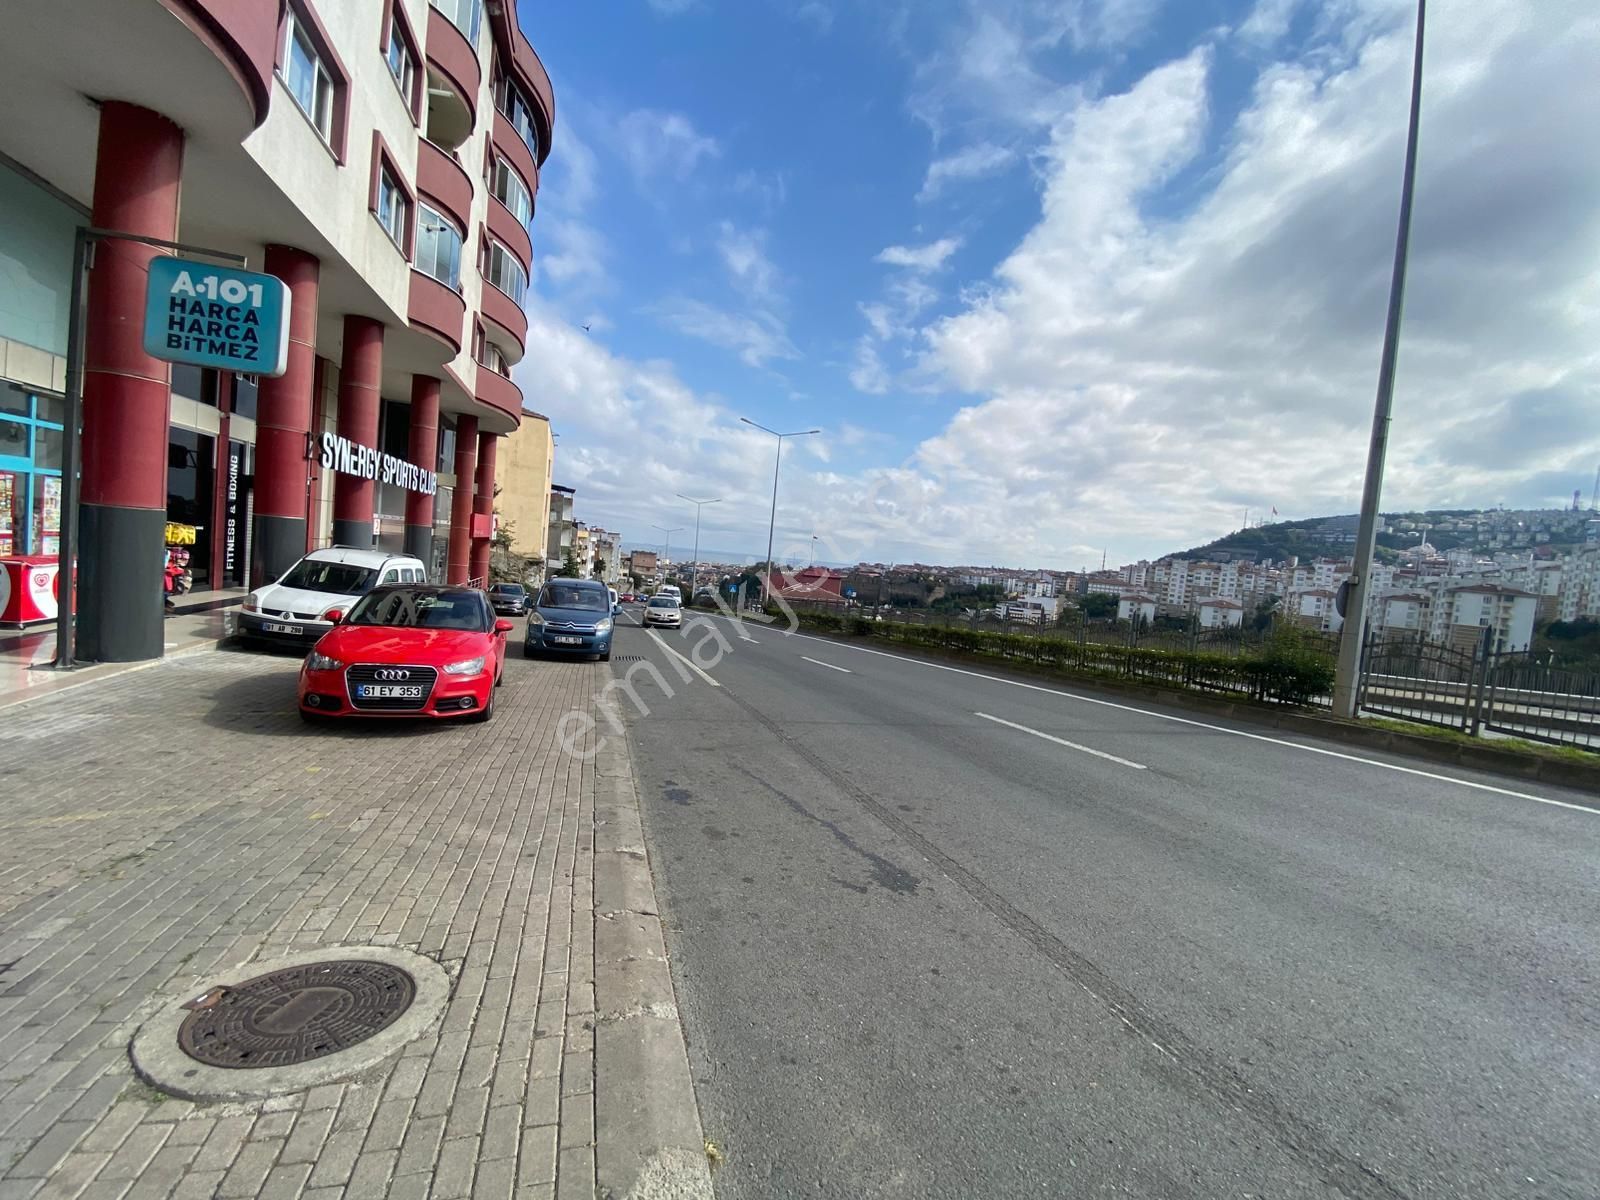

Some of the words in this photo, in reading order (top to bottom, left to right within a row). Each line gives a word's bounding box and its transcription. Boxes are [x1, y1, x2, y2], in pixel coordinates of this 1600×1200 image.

[169, 296, 259, 326] HARCA
[168, 314, 259, 344] HARCA
[229, 455, 238, 500] BOXING
[322, 431, 381, 480] SYNERGY
[383, 453, 418, 491] SPORTS
[419, 468, 437, 496] CLUB
[229, 504, 236, 513] &
[226, 518, 235, 570] FITNESS
[363, 686, 375, 696] 61
[379, 686, 394, 696] EY
[399, 686, 421, 697] 353
